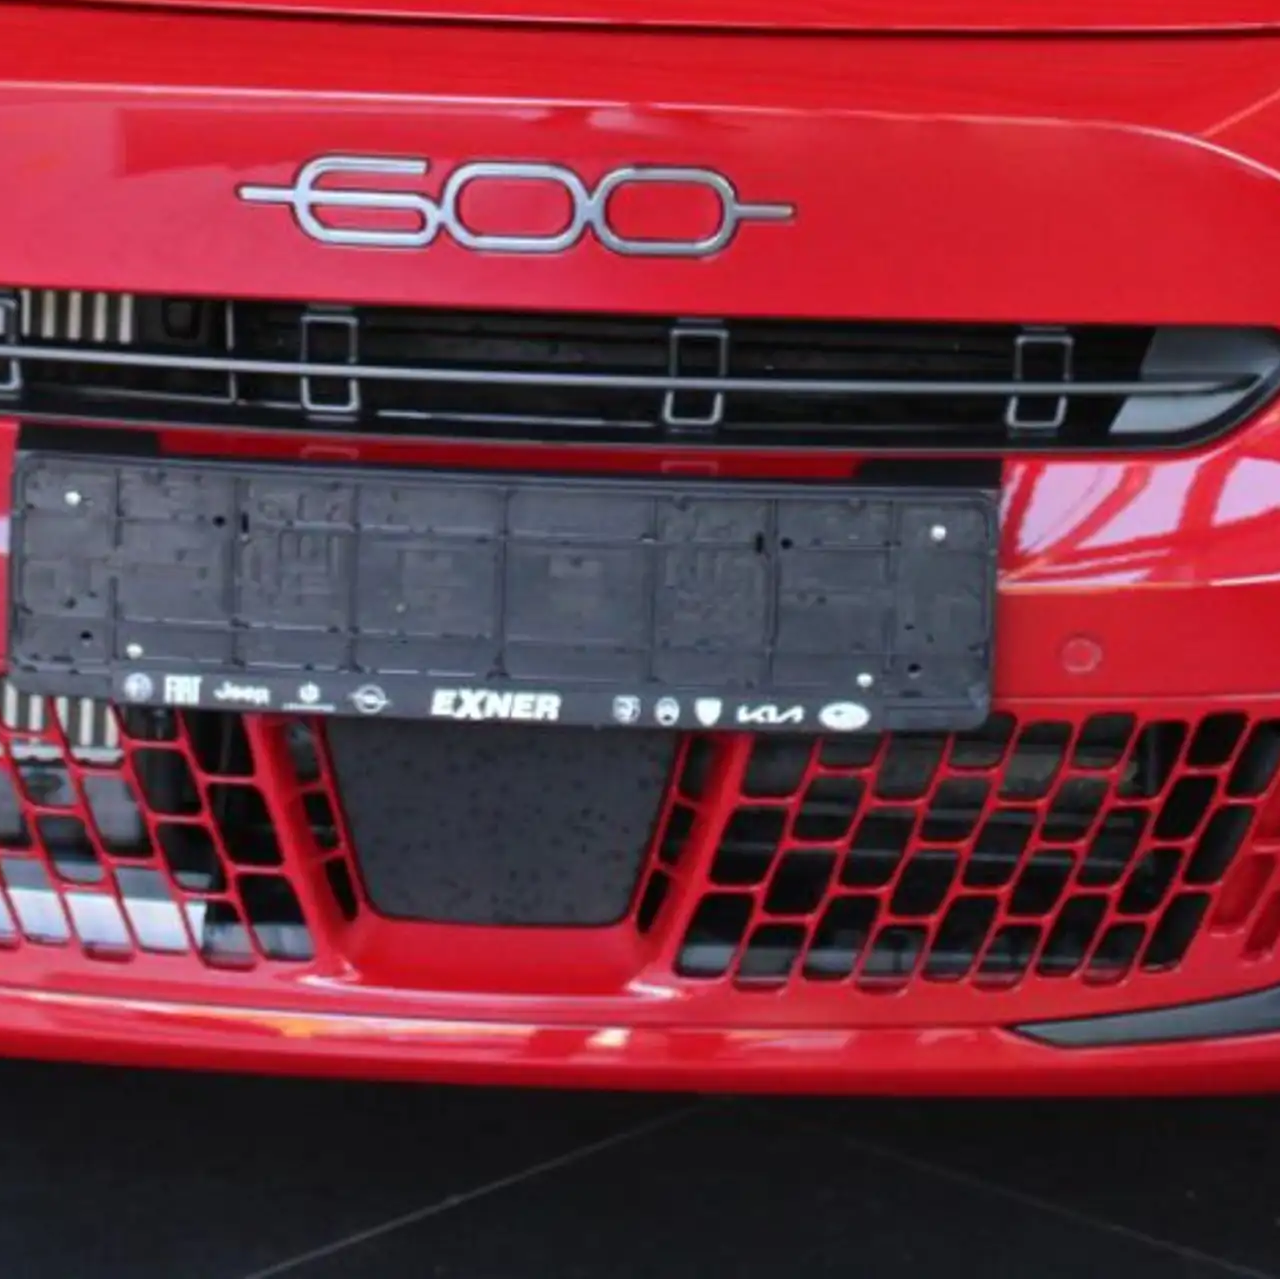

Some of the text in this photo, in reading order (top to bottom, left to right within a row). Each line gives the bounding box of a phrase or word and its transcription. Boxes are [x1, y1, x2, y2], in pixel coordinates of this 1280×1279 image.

[280, 154, 750, 260] 600
[213, 680, 270, 705] Jeep
[430, 686, 563, 721] EXNER
[736, 703, 804, 725] KIA
